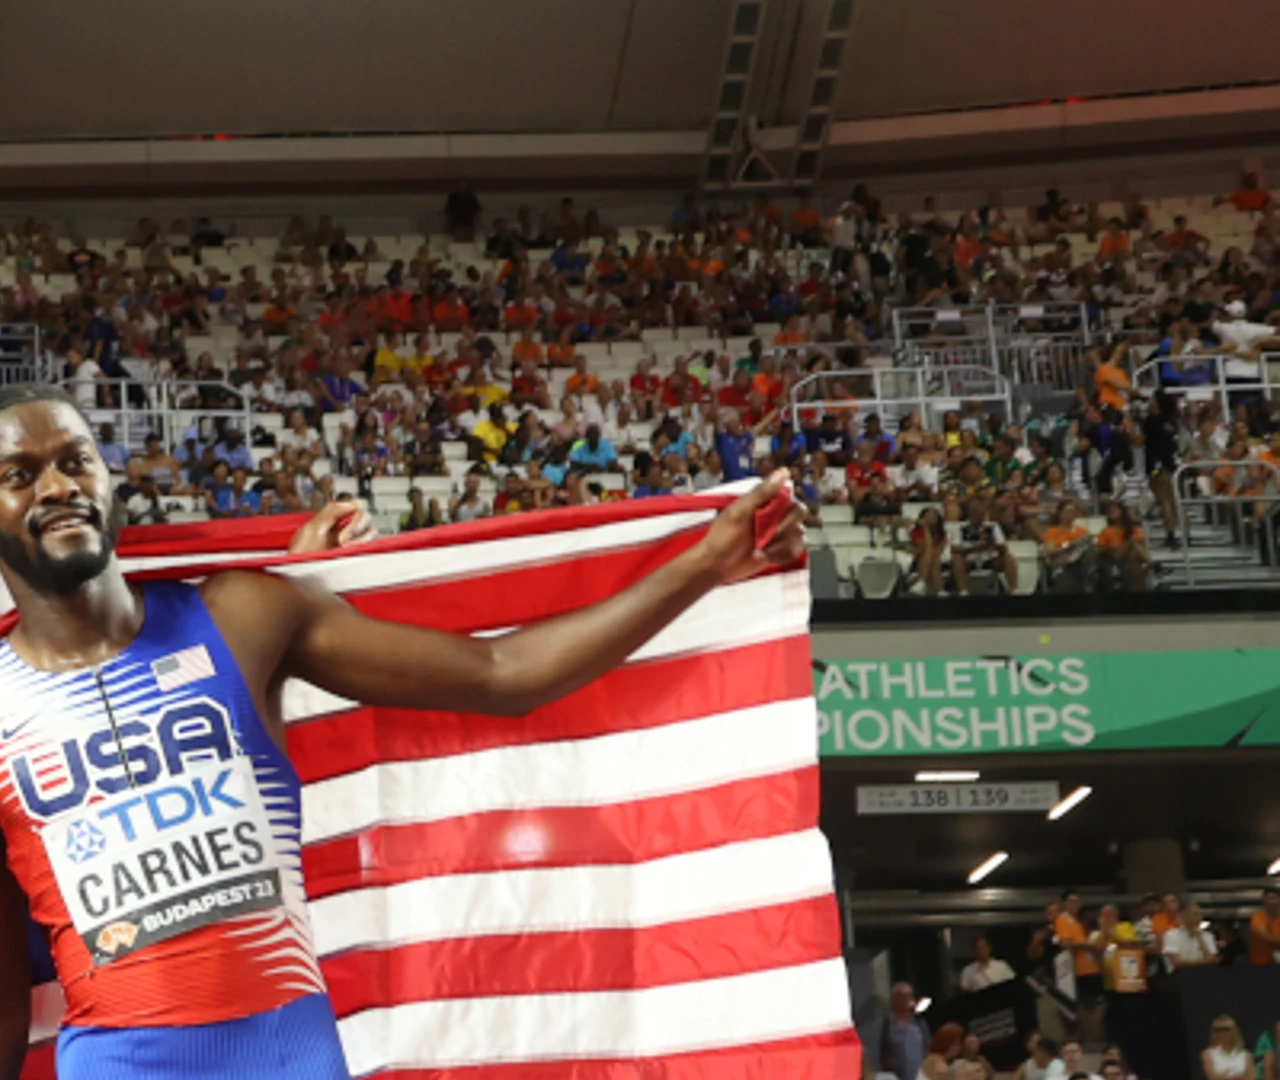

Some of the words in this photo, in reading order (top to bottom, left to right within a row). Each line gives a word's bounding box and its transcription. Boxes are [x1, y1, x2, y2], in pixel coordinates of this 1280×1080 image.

[817, 657, 1090, 700] ATHLETICS
[10, 700, 235, 818] USA
[98, 768, 246, 843] TDK
[909, 789, 950, 809] 138
[968, 787, 1009, 807] 139
[76, 820, 266, 918] CARNES
[142, 883, 253, 933] BUDAPEST
